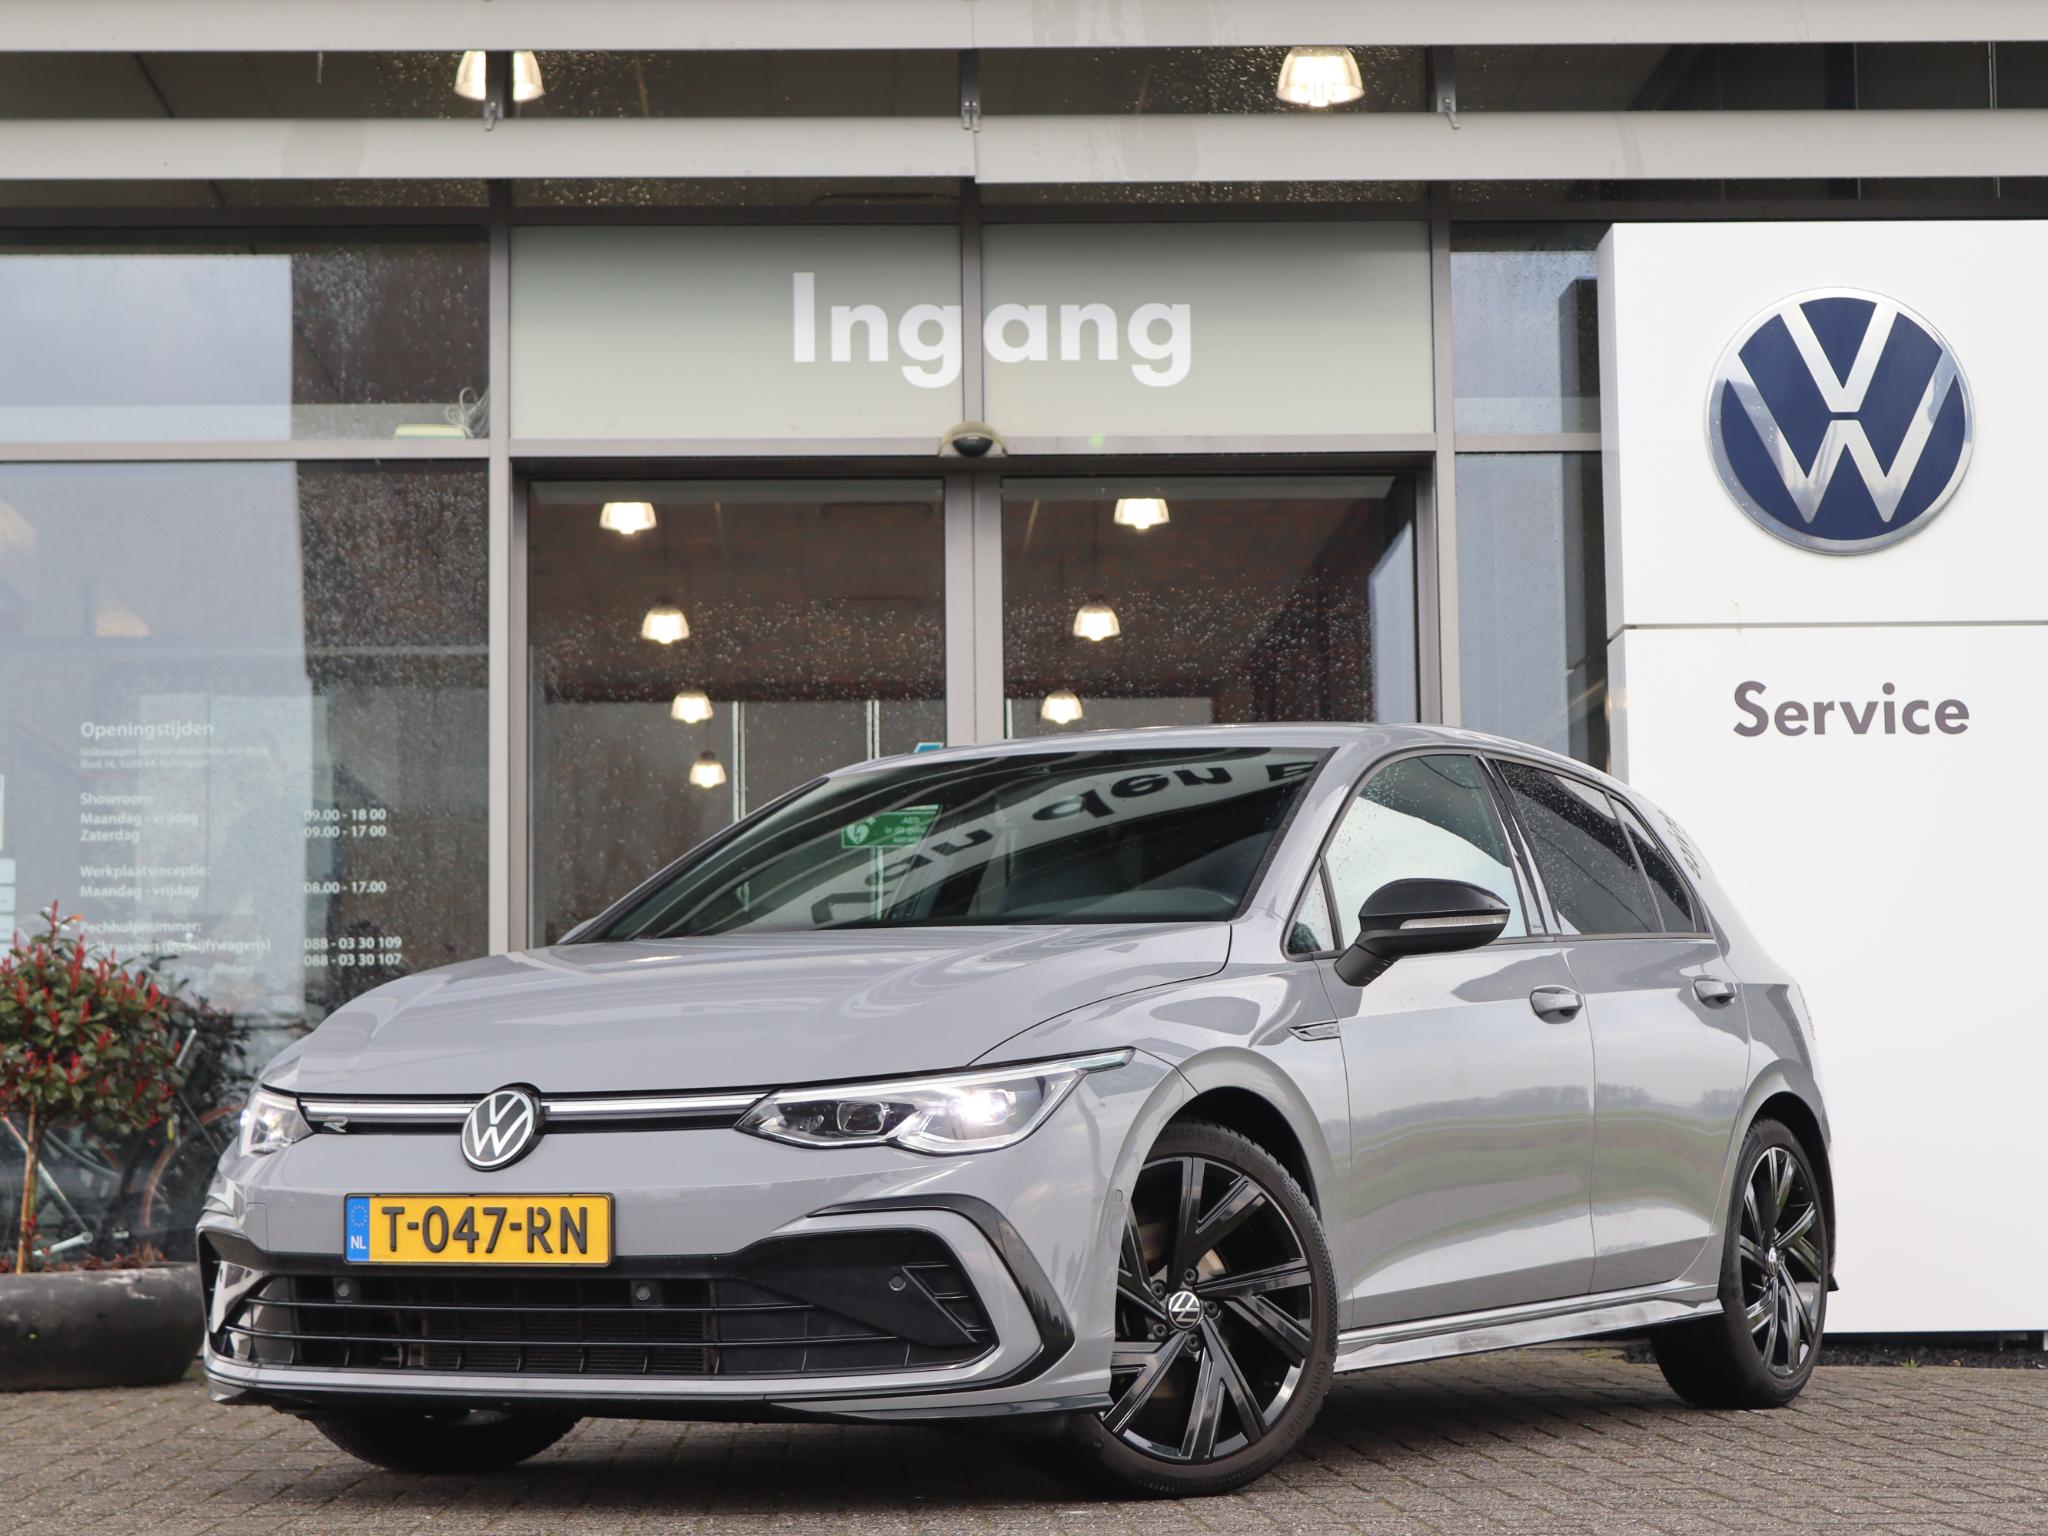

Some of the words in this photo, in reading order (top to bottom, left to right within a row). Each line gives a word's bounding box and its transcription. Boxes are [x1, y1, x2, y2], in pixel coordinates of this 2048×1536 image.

[793, 271, 1191, 389] Ingang
[1733, 680, 1970, 738] Service
[80, 720, 214, 740] Openingstijden
[80, 812, 142, 826] Maandag
[153, 812, 200, 827] vrijdag
[80, 829, 140, 843] Zaterdag
[303, 825, 340, 838] 09.00
[80, 884, 142, 900] Maandag
[153, 884, 200, 899] vrijdag
[303, 881, 340, 894] 08.00
[351, 880, 387, 894] 17.00
[82, 940, 159, 954] lkwagen
[303, 937, 328, 950] 088
[338, 936, 356, 950] 03
[358, 936, 375, 949] 30
[378, 935, 402, 949] 109
[303, 954, 328, 967] 088
[338, 953, 356, 966] 03
[358, 953, 375, 966] 30
[378, 952, 402, 966] 107
[381, 1205, 589, 1255] T-047-RN
[350, 1235, 367, 1250] NL
